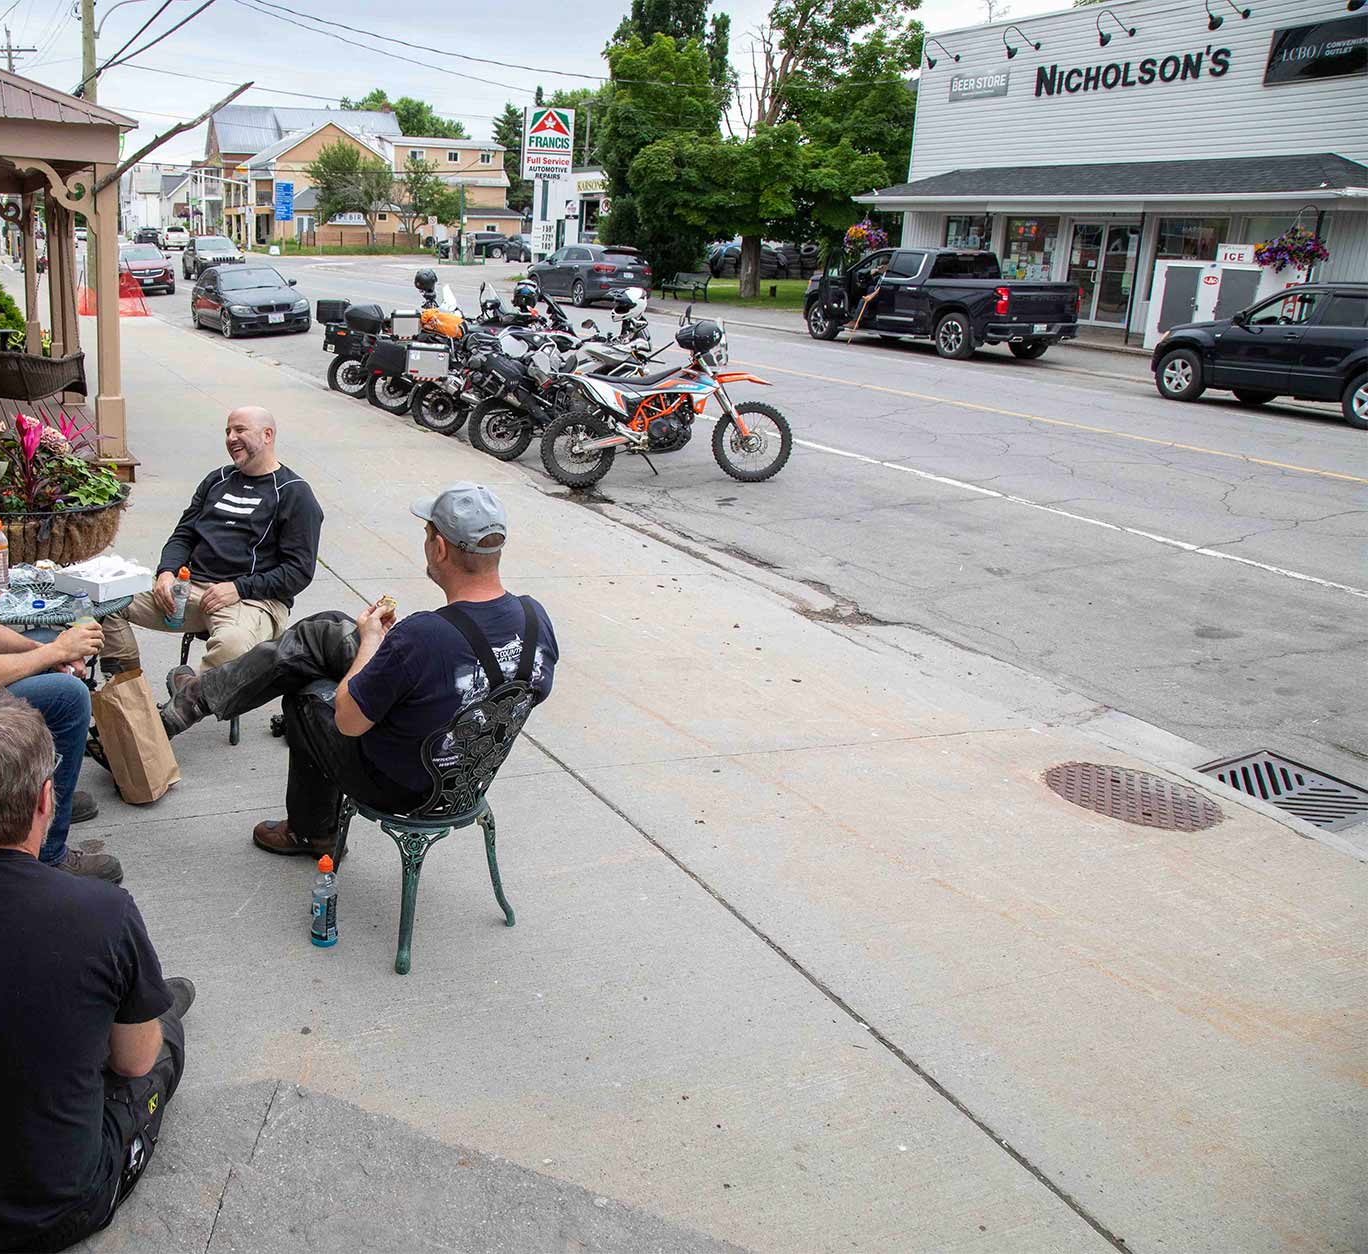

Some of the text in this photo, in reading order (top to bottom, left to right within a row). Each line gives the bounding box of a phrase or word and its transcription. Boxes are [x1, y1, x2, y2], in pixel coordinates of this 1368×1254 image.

[1282, 45, 1316, 62] LCBO
[1325, 46, 1353, 56] OUTLET
[952, 74, 1007, 92] BEER STORE
[529, 136, 570, 149] FRANCIS
[527, 156, 569, 166] Full Service
[1223, 252, 1245, 262] ICE
